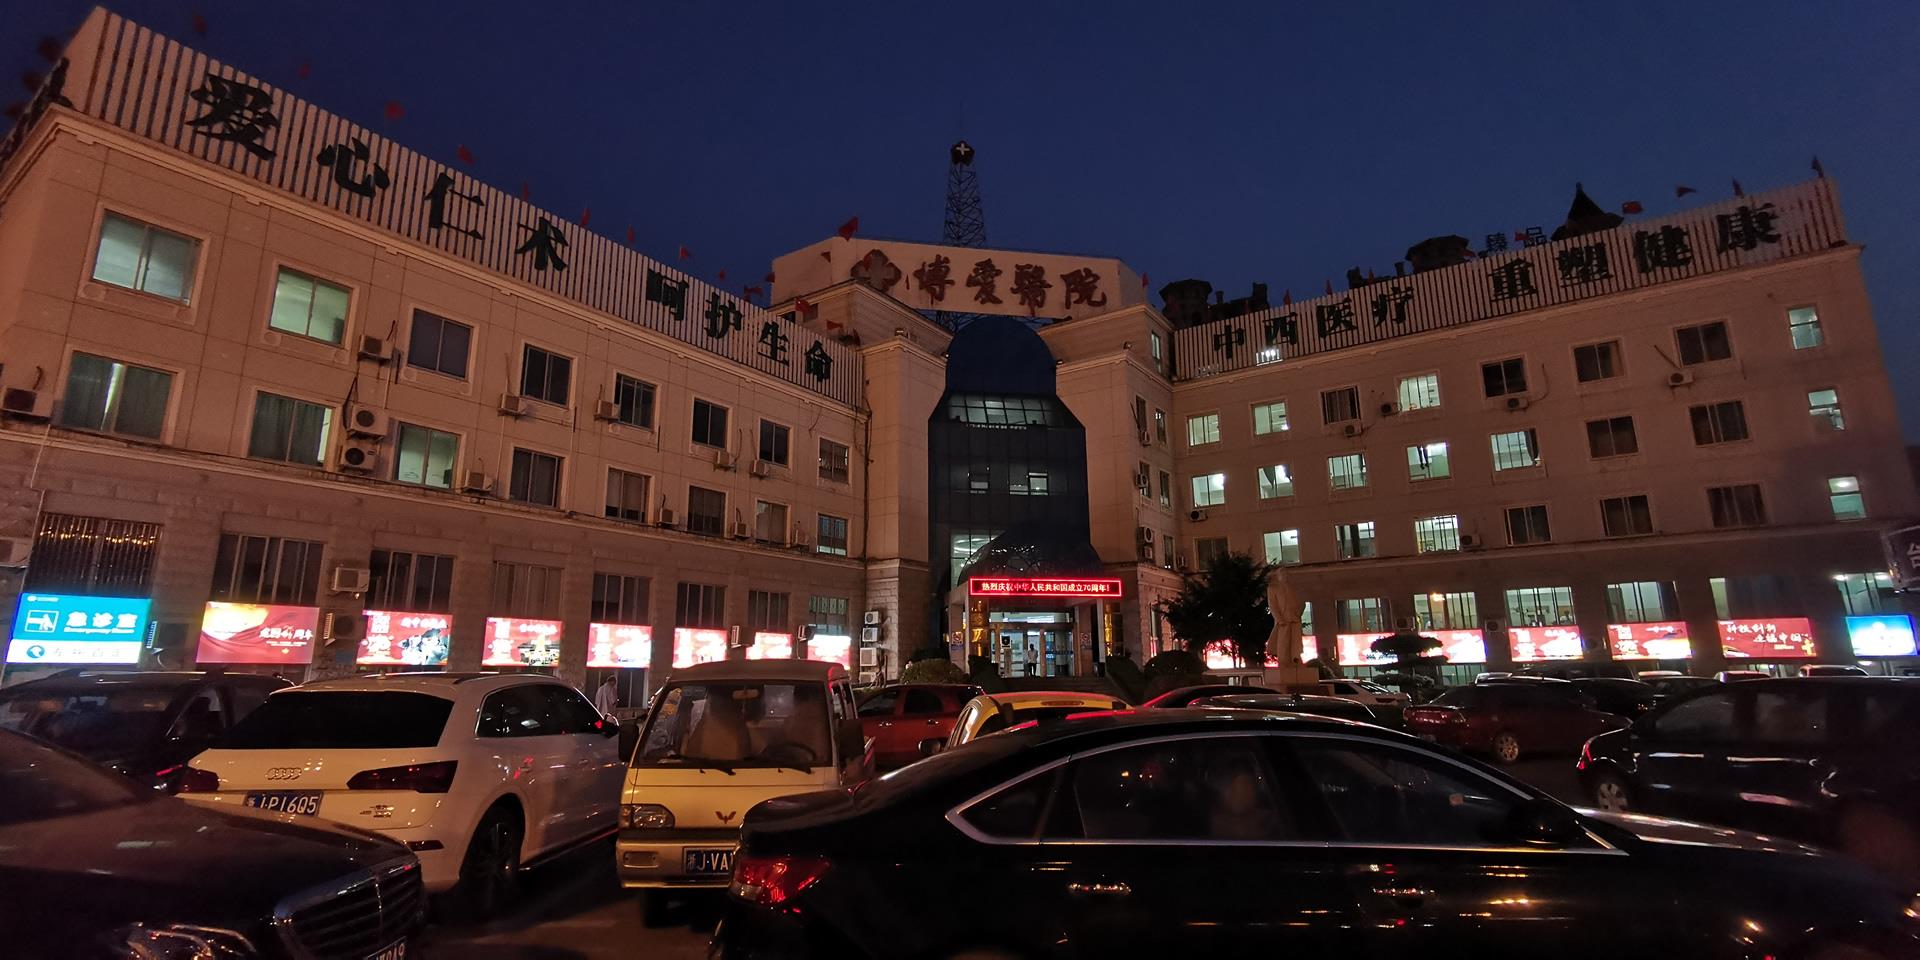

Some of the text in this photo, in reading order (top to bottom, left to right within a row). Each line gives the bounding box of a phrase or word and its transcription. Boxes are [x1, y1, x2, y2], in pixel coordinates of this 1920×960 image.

[186, 73, 570, 272] 爱心仁术
[646, 268, 833, 382] 呵护生命
[1213, 202, 1782, 360] 中西医疗 重塑健康
[67, 610, 139, 629] 急诊室
